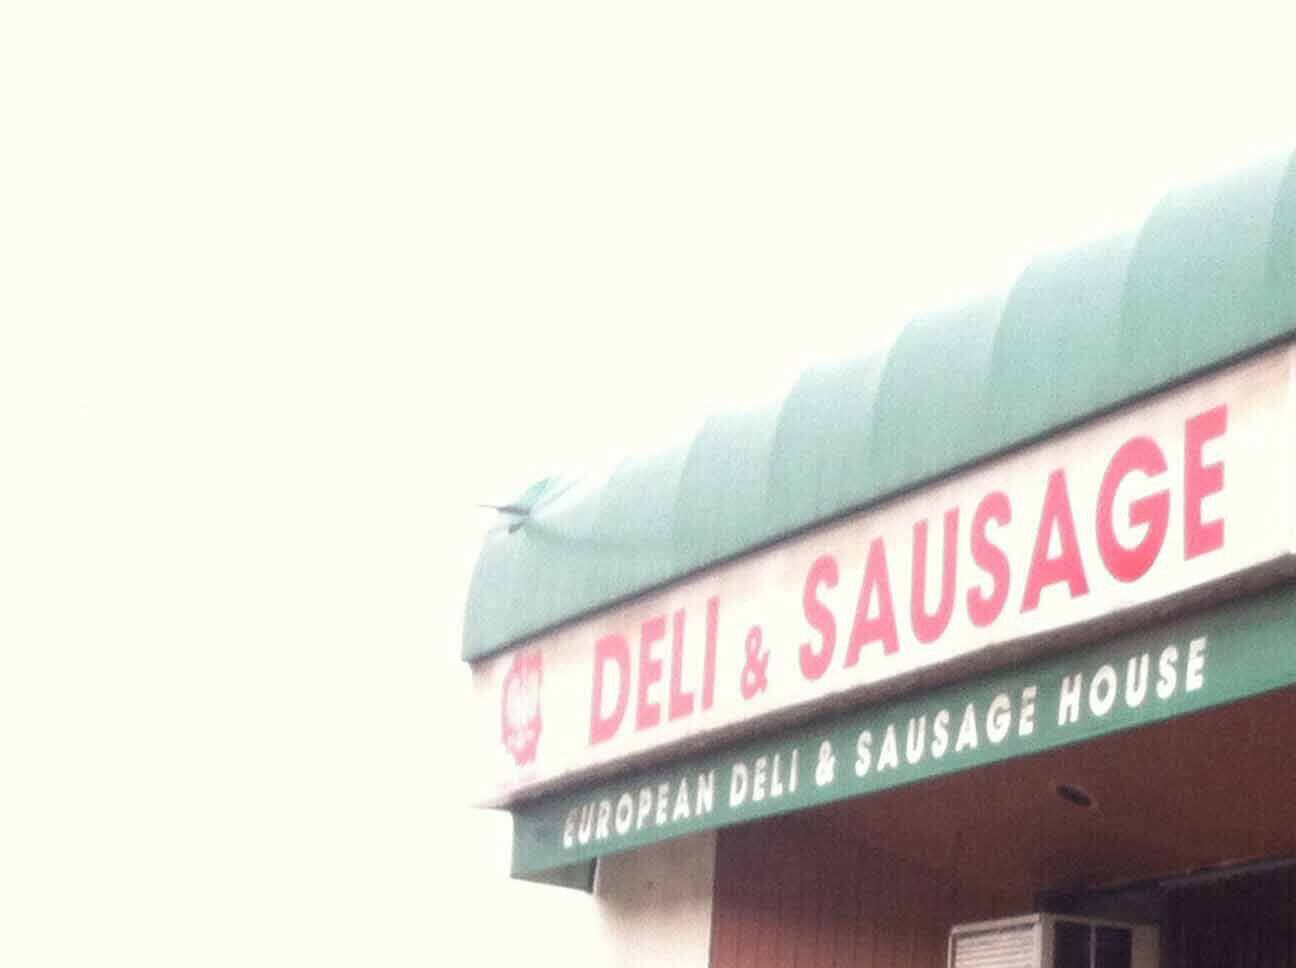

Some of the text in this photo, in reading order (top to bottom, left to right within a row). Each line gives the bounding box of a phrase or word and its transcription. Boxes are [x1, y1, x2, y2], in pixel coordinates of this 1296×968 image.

[588, 403, 1230, 746] DELI & SAUSAGE
[562, 635, 1209, 849] EUROPEAN DELI & SAUSAGE HOUSE
